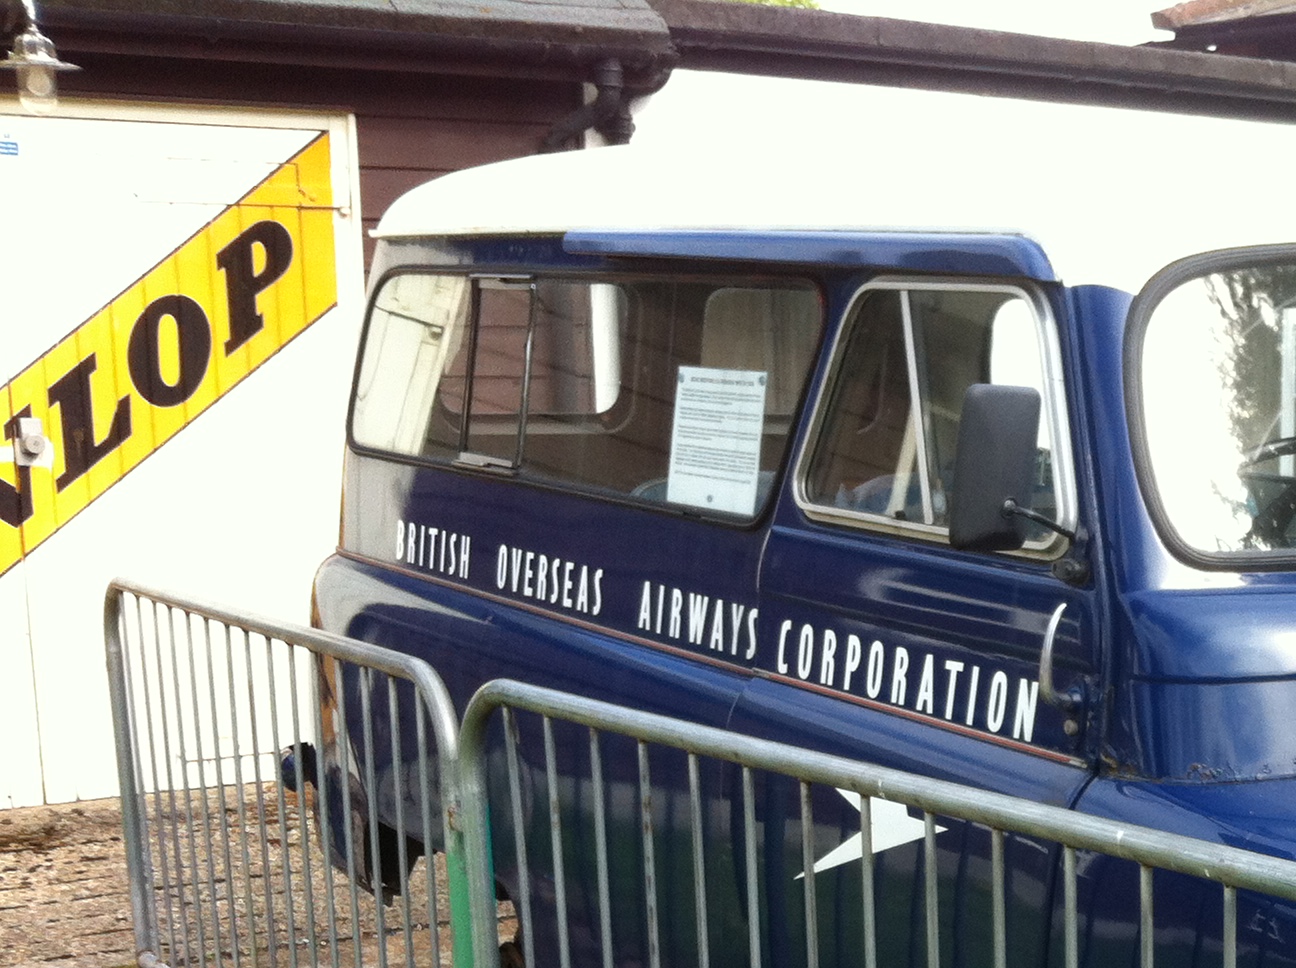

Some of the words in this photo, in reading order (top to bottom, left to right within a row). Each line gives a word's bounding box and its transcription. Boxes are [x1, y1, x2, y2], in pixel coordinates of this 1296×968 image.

[395, 519, 471, 579] BRITISH
[496, 544, 604, 616] OVERSEAS
[638, 580, 759, 660] AIRWAYS
[777, 619, 1040, 743] CORPORATION
